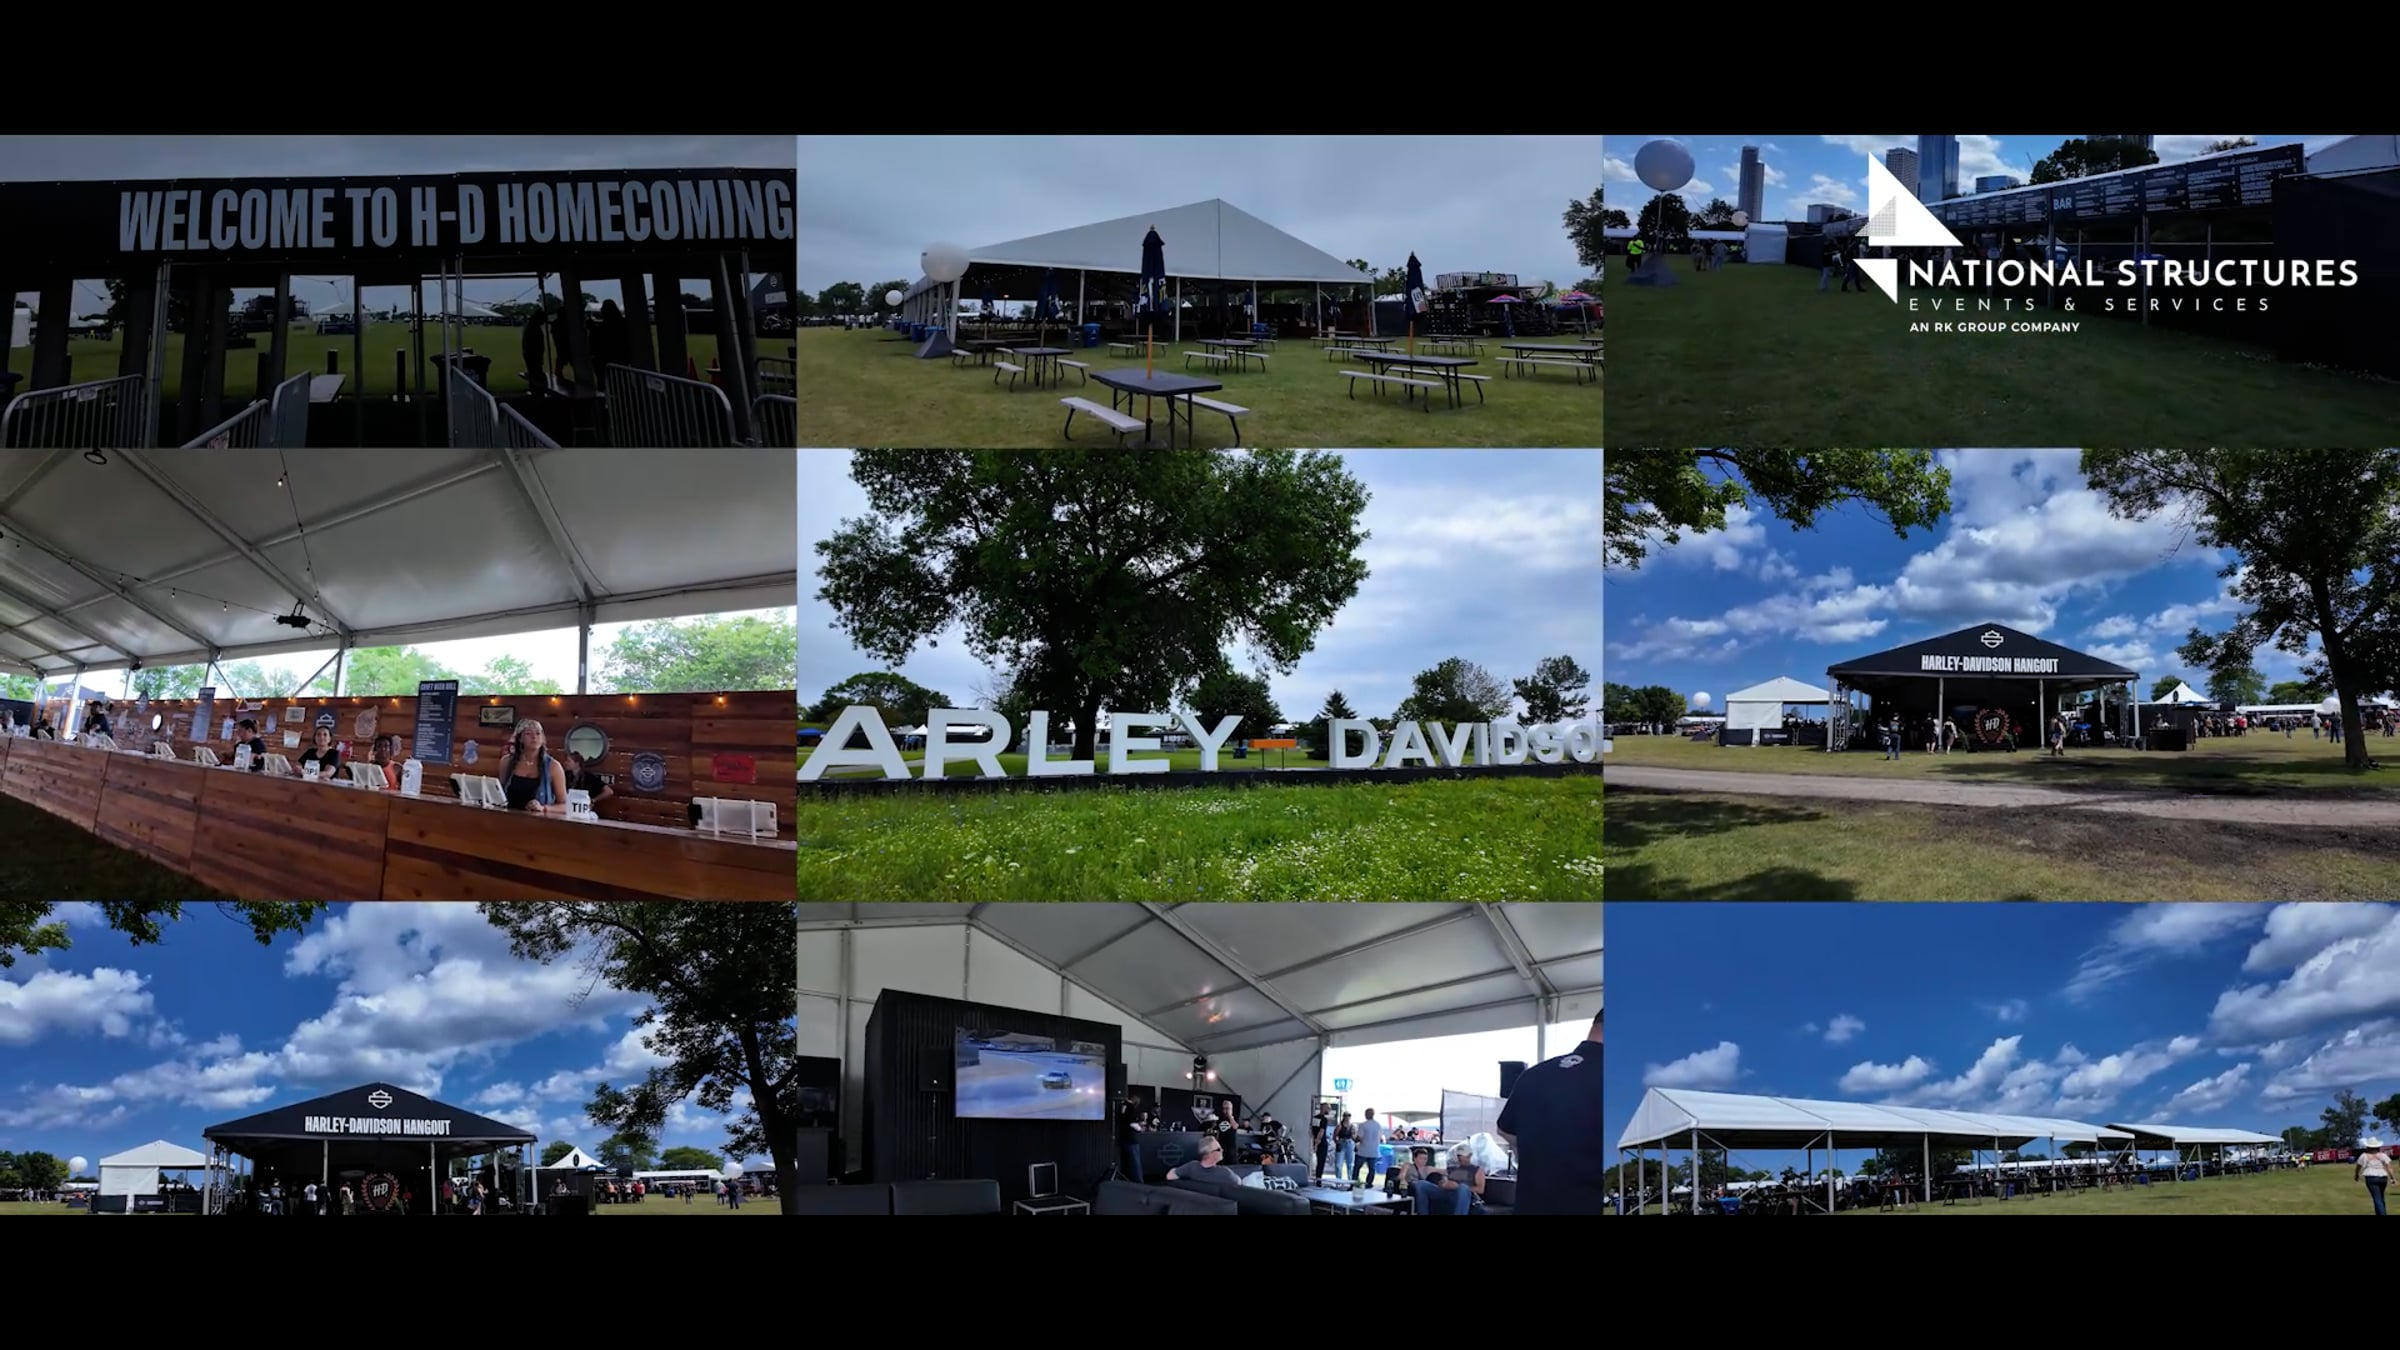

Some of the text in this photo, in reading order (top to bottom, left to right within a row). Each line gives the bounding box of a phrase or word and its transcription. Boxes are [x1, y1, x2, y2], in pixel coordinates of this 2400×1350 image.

[2053, 197, 2073, 211] BAR
[119, 179, 794, 252] WELCOME TO H-D HOMECOMING
[1921, 654, 2059, 673] HARLEY-DAVIDSON HANGOUT
[797, 704, 1604, 780] ARLEY DAVIDSO
[304, 1115, 451, 1135] HARLEY-DAVIDSON HANGOUT
